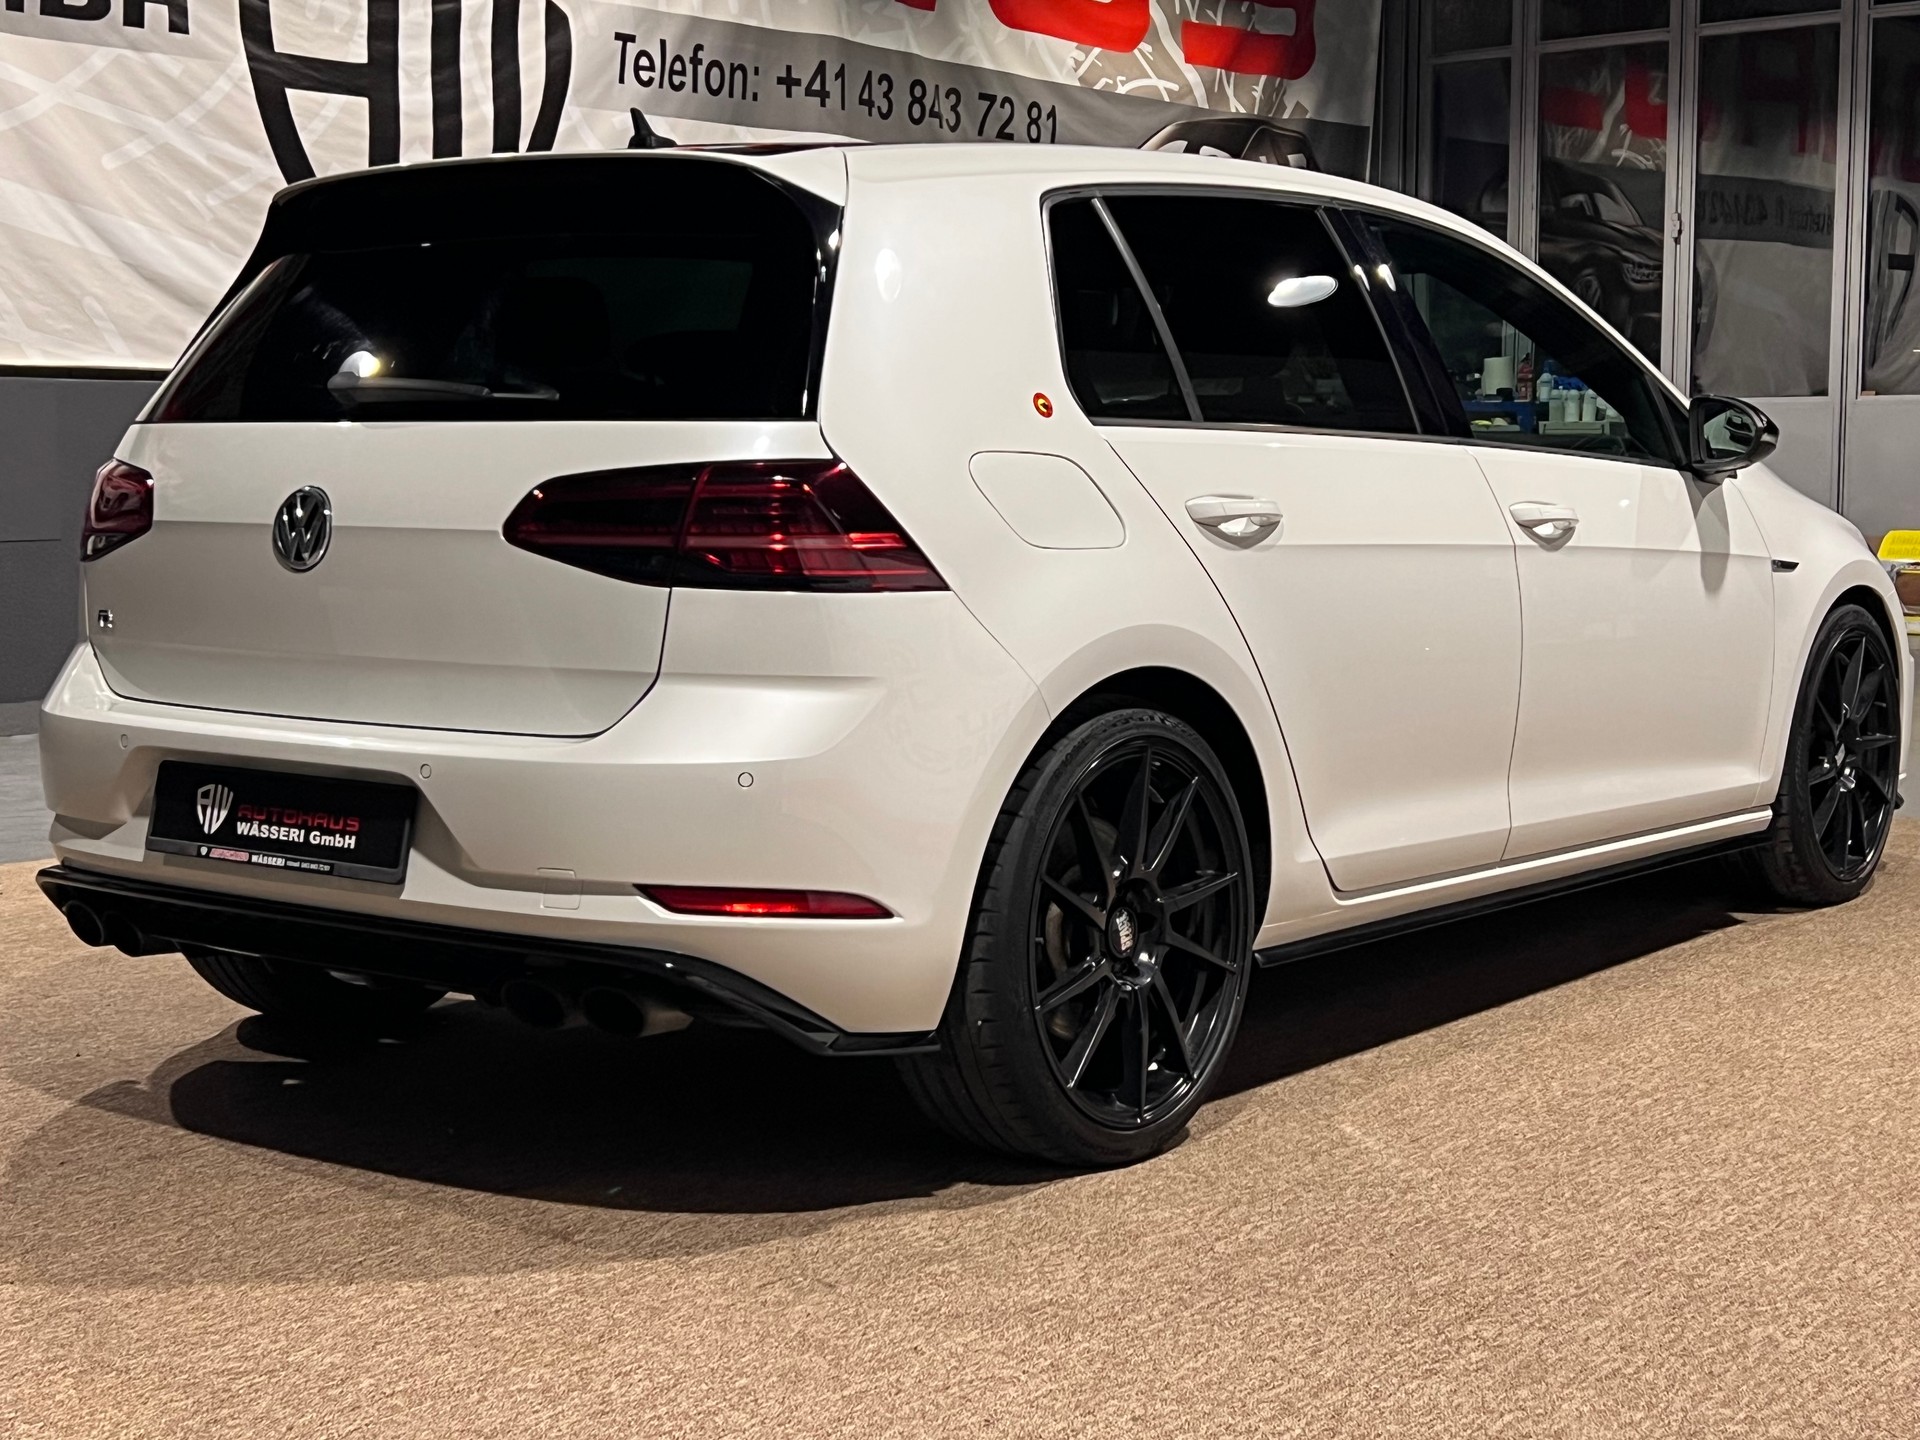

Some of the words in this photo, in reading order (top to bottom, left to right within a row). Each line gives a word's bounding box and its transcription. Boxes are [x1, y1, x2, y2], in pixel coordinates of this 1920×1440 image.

[614, 31, 760, 102] Telefon:
[776, 59, 846, 111] +41
[858, 69, 894, 121] 43
[907, 78, 962, 133] 843
[977, 91, 1015, 141] 72
[1026, 100, 1058, 144] 81
[237, 804, 361, 832] AUTOHAUS
[236, 820, 306, 843] WÄSSERI
[309, 831, 357, 849] GmbH
